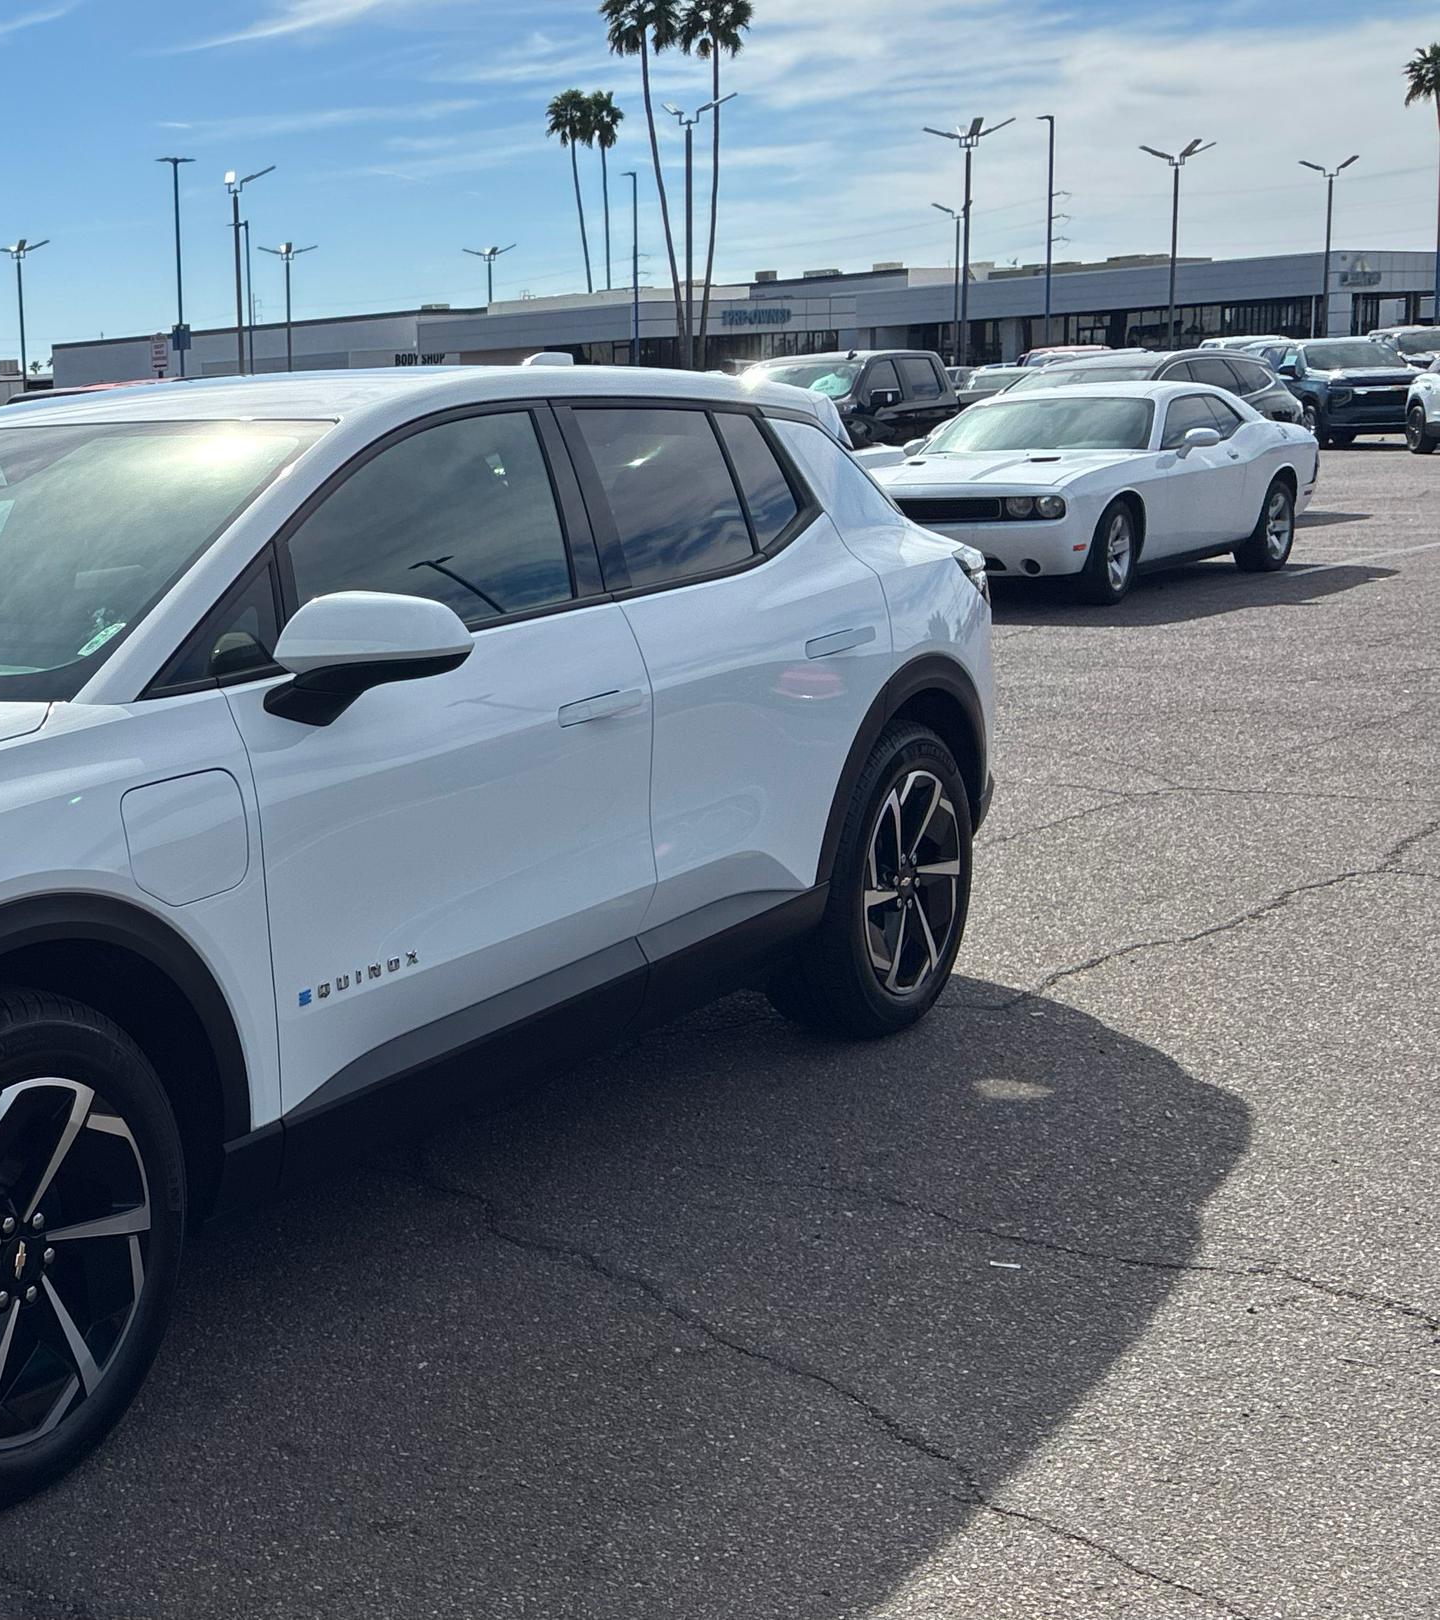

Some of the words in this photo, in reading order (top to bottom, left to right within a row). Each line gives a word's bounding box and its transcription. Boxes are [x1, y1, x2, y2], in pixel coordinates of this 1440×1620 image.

[395, 353, 418, 366] BODY
[421, 352, 445, 365] SHOP
[298, 950, 419, 1007] EQUINOX
